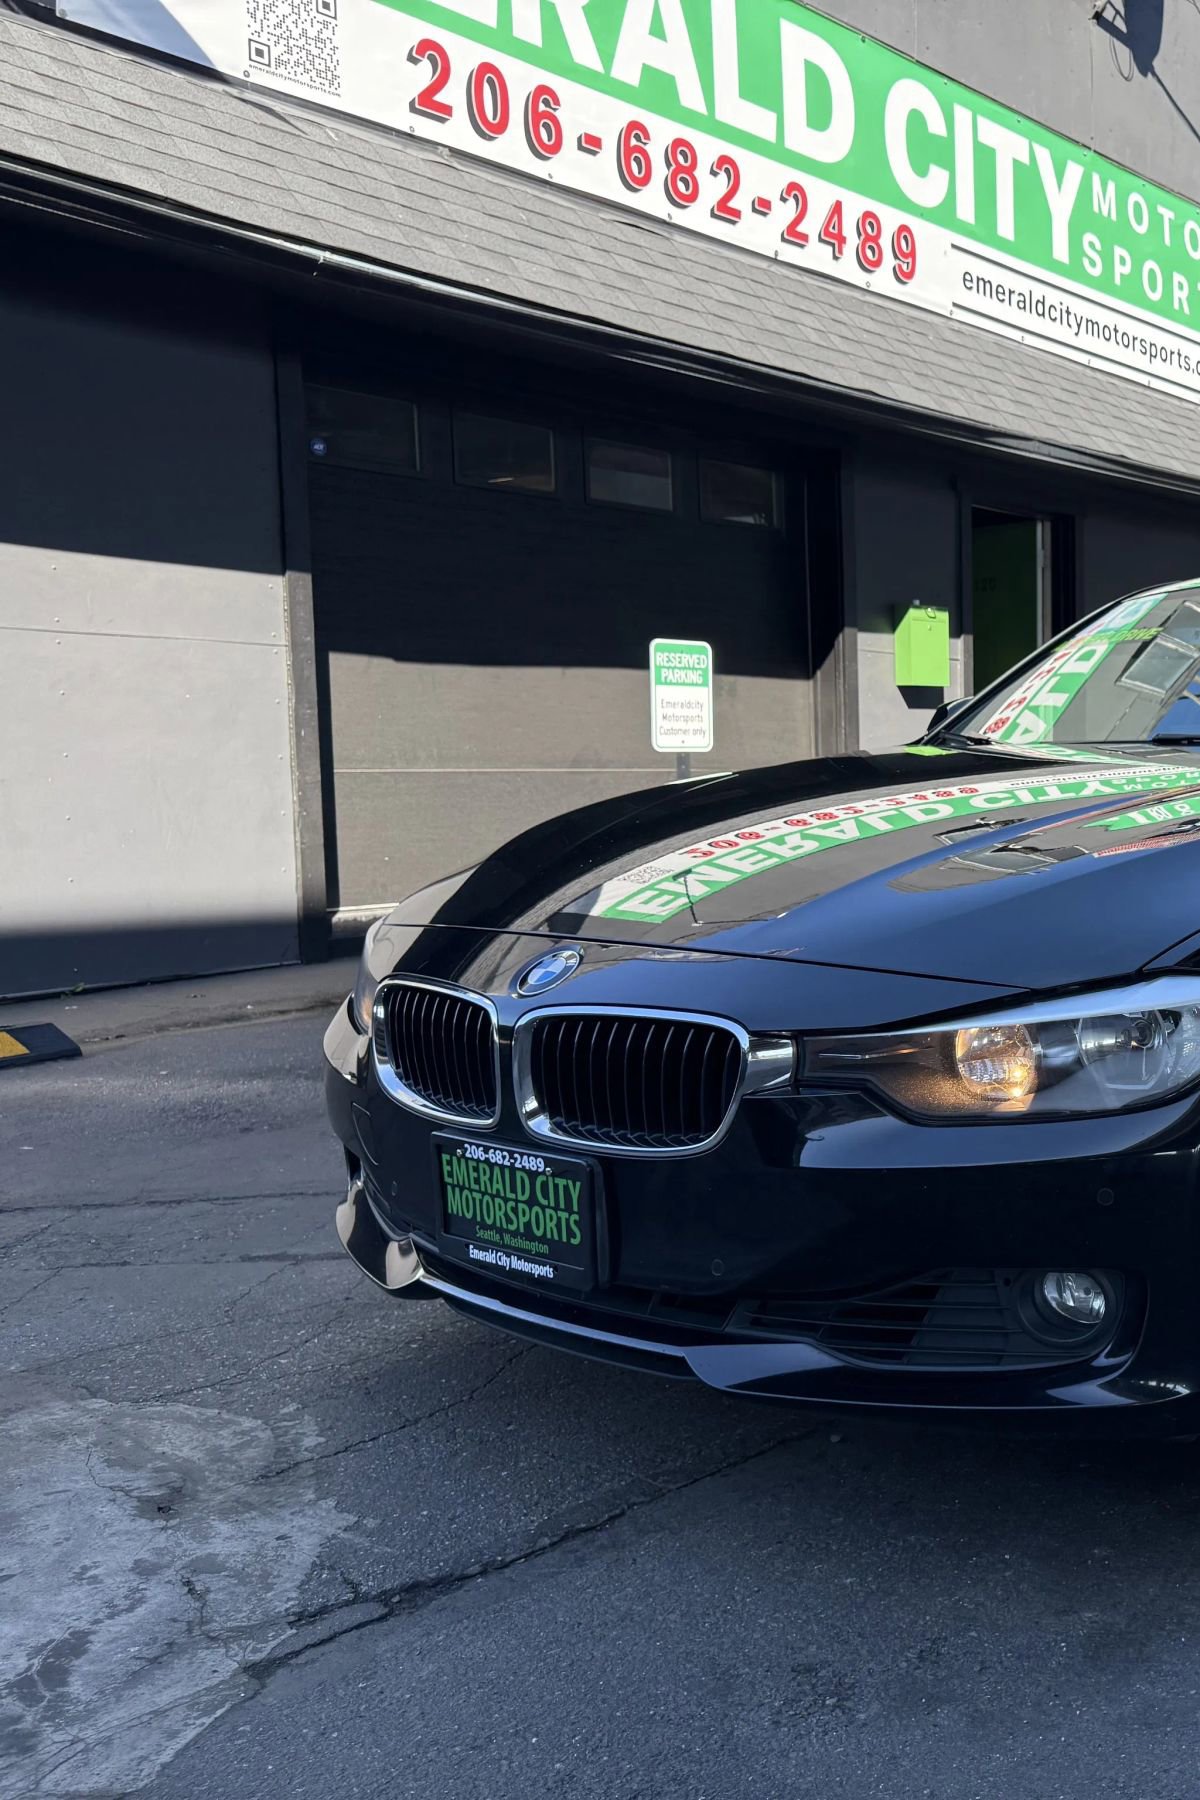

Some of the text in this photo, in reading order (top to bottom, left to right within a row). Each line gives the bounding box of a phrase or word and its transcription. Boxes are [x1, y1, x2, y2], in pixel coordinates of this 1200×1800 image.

[430, 0, 1085, 265] ALD CITY
[406, 38, 918, 284] 206-682-2489
[655, 651, 708, 669] RESERVED
[660, 667, 704, 684] PARKING
[659, 725, 707, 739] Customer only
[662, 712, 704, 725] Motorsports
[463, 1143, 546, 1173] 206-682-2489
[441, 1153, 582, 1212] EMERALD CITY
[446, 1184, 582, 1246] MOTORSPORTS
[475, 1225, 549, 1255] Seattle, Washington
[469, 1244, 554, 1279] Emerald City Motorsports
